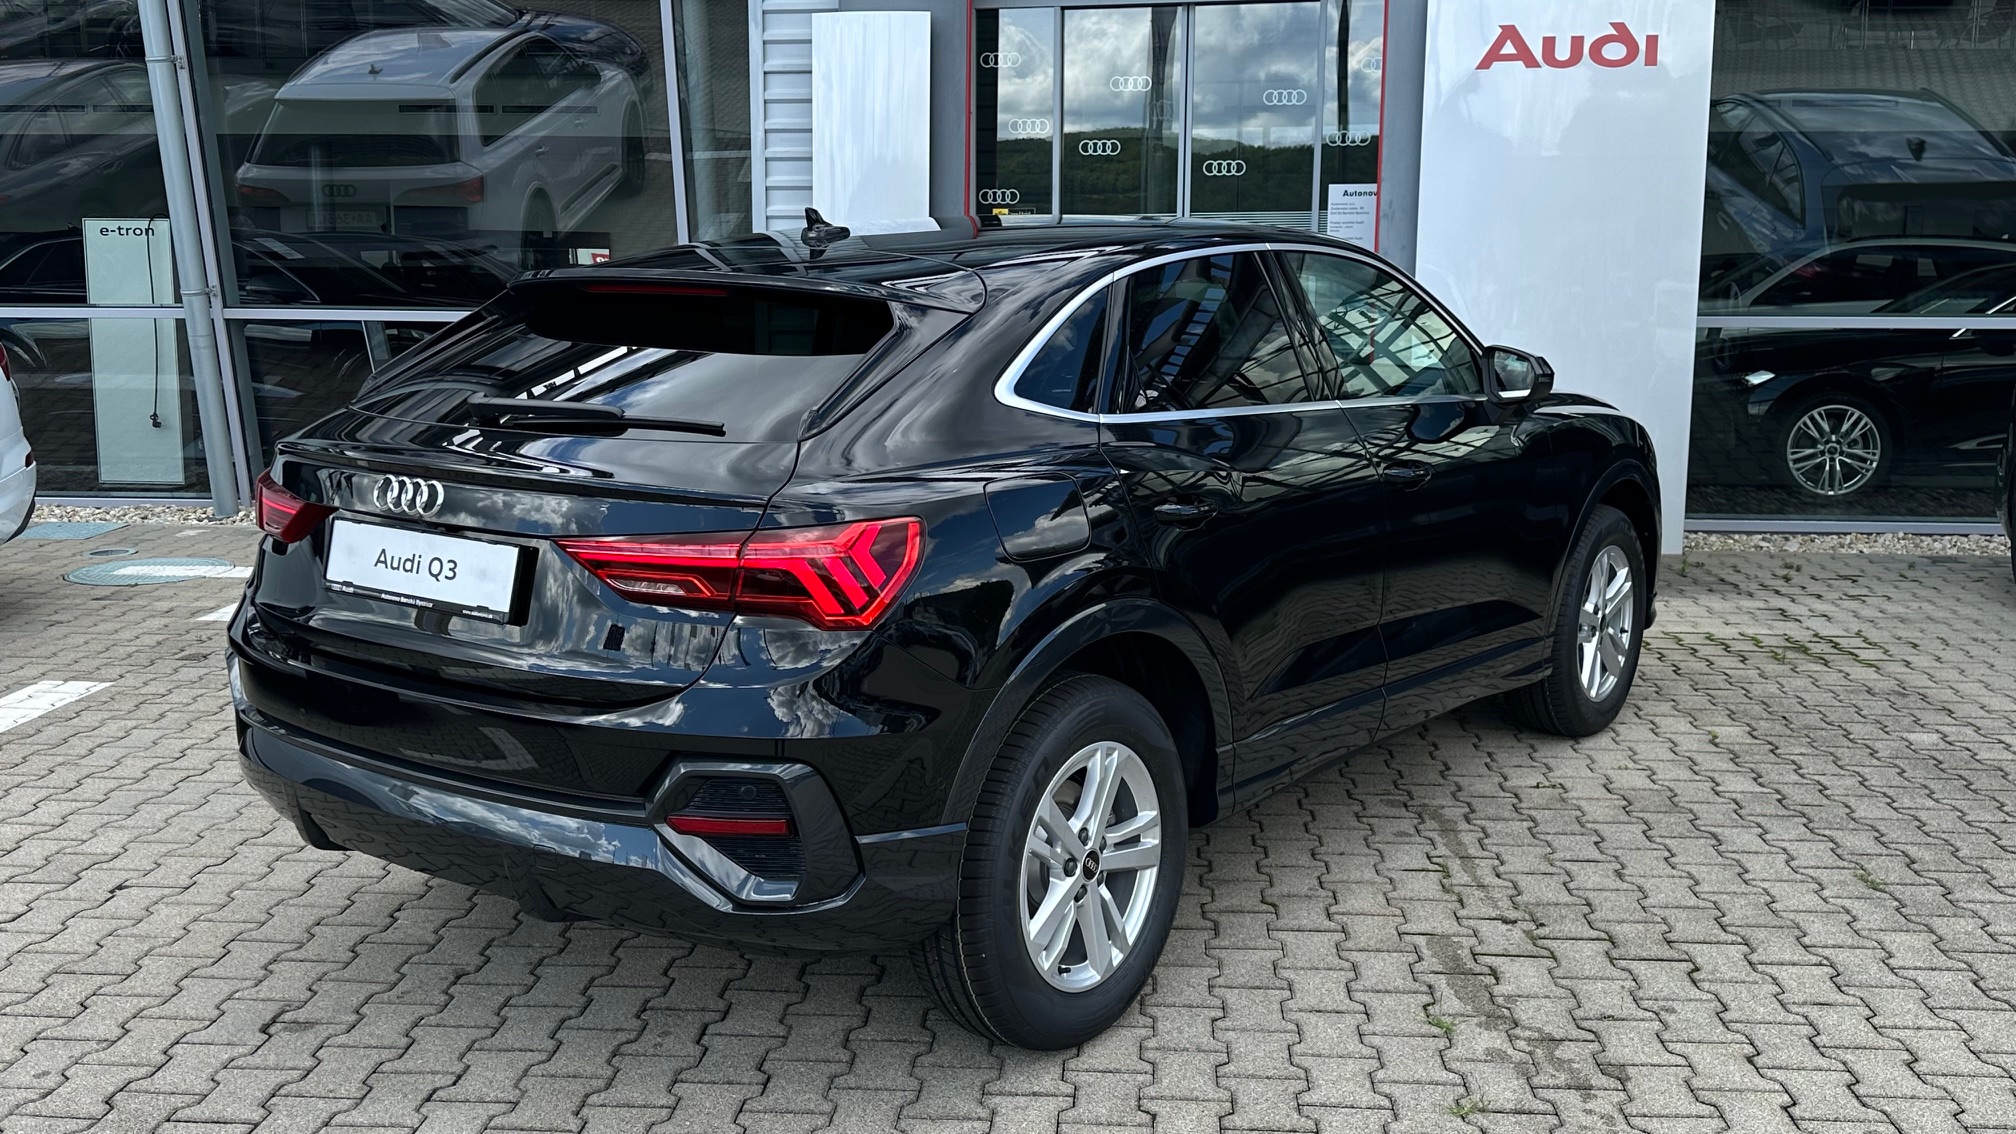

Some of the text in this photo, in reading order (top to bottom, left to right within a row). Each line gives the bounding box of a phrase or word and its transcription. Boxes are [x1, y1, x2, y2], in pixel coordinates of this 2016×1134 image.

[1475, 22, 1659, 70] Audi
[100, 226, 154, 236] e-tron
[374, 549, 457, 582] Audi Q3
